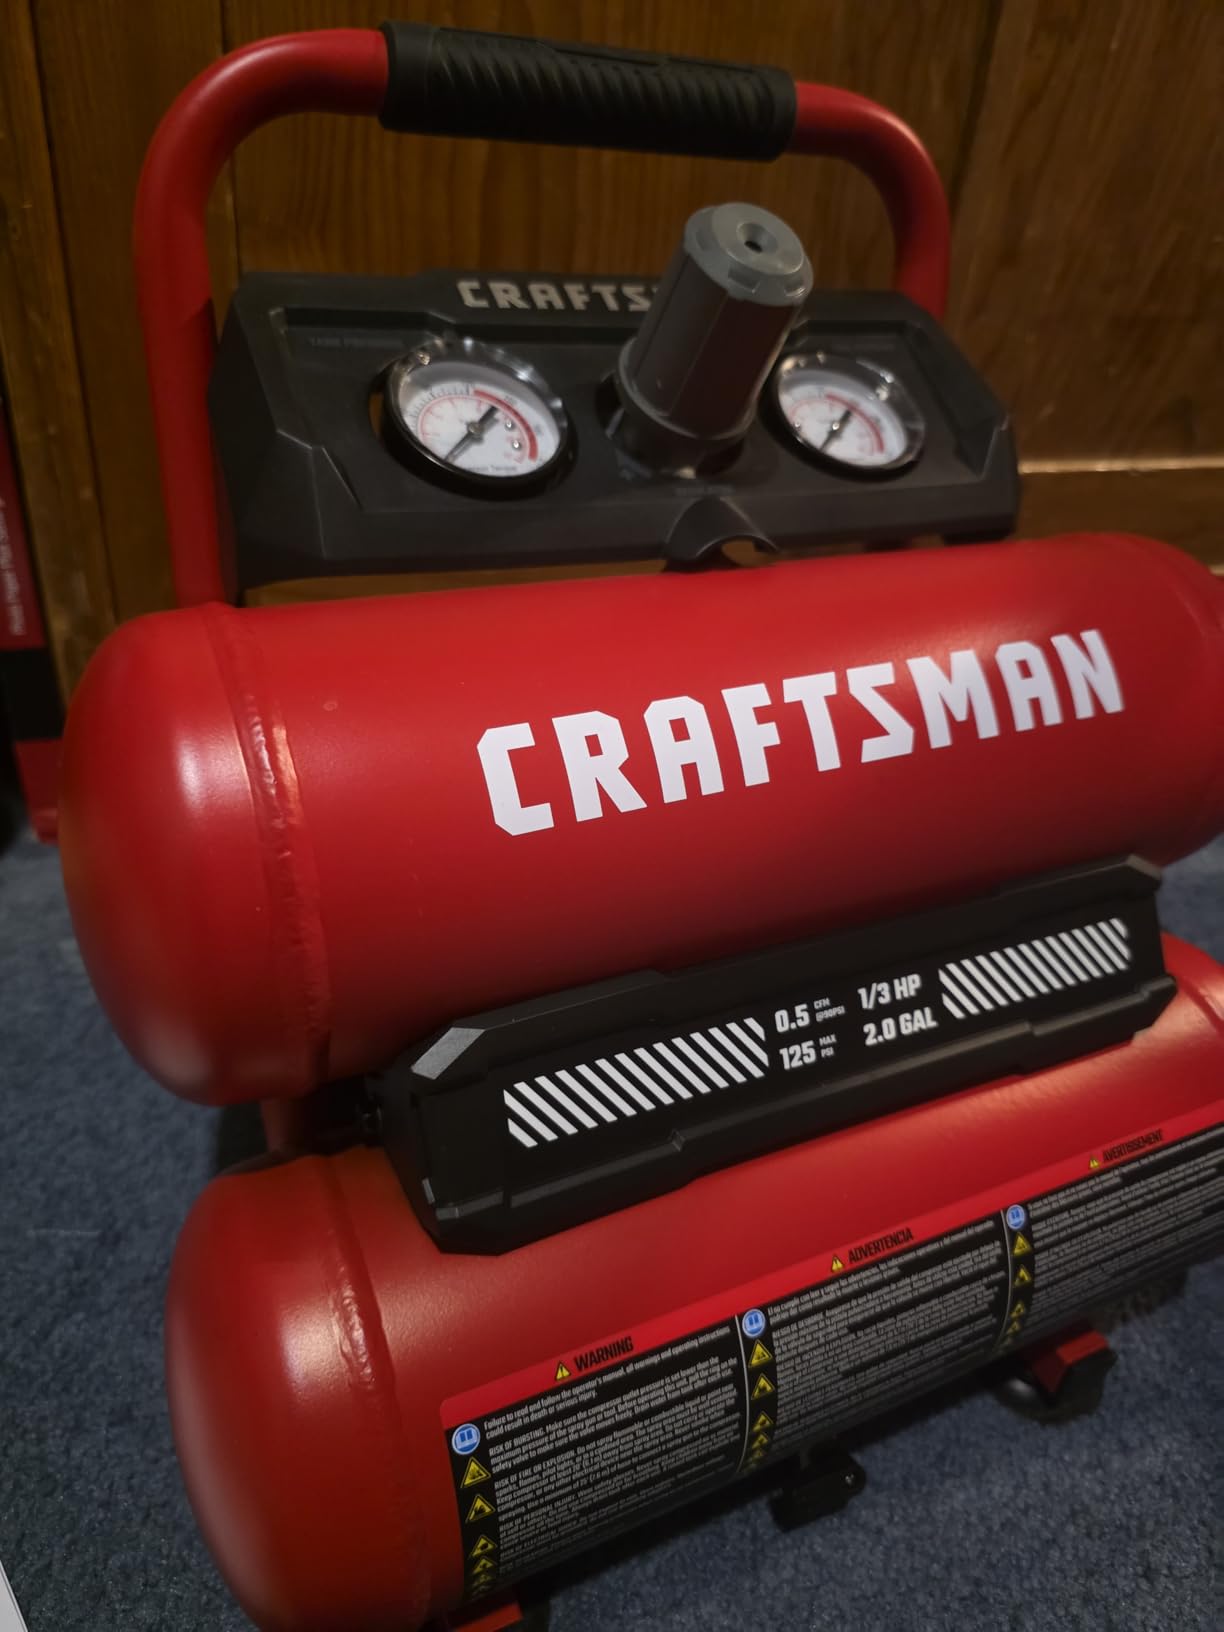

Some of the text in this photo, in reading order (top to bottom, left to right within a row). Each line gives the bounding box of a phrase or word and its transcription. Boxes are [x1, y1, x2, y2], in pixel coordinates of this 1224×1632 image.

[456, 279, 657, 312] CRAFTS
[477, 629, 1125, 837] CRAFTSMAN
[813, 997, 831, 1010] CFM
[857, 973, 922, 1010] 1/3 HP
[774, 1003, 810, 1033] 0.5
[815, 1005, 846, 1023] @90PSI
[863, 1007, 939, 1046] 2.0 GAL
[779, 1040, 817, 1071] 125
[819, 1034, 837, 1046] MAX
[820, 1047, 835, 1059] PSI
[848, 1227, 914, 1264] ADVERTENCIA
[574, 1337, 634, 1372] WARNING
[485, 1425, 503, 1439] could
[504, 1417, 522, 1431] result
[529, 1407, 547, 1421] death
[555, 1396, 577, 1411] serious
[578, 1388, 597, 1402] injury.
